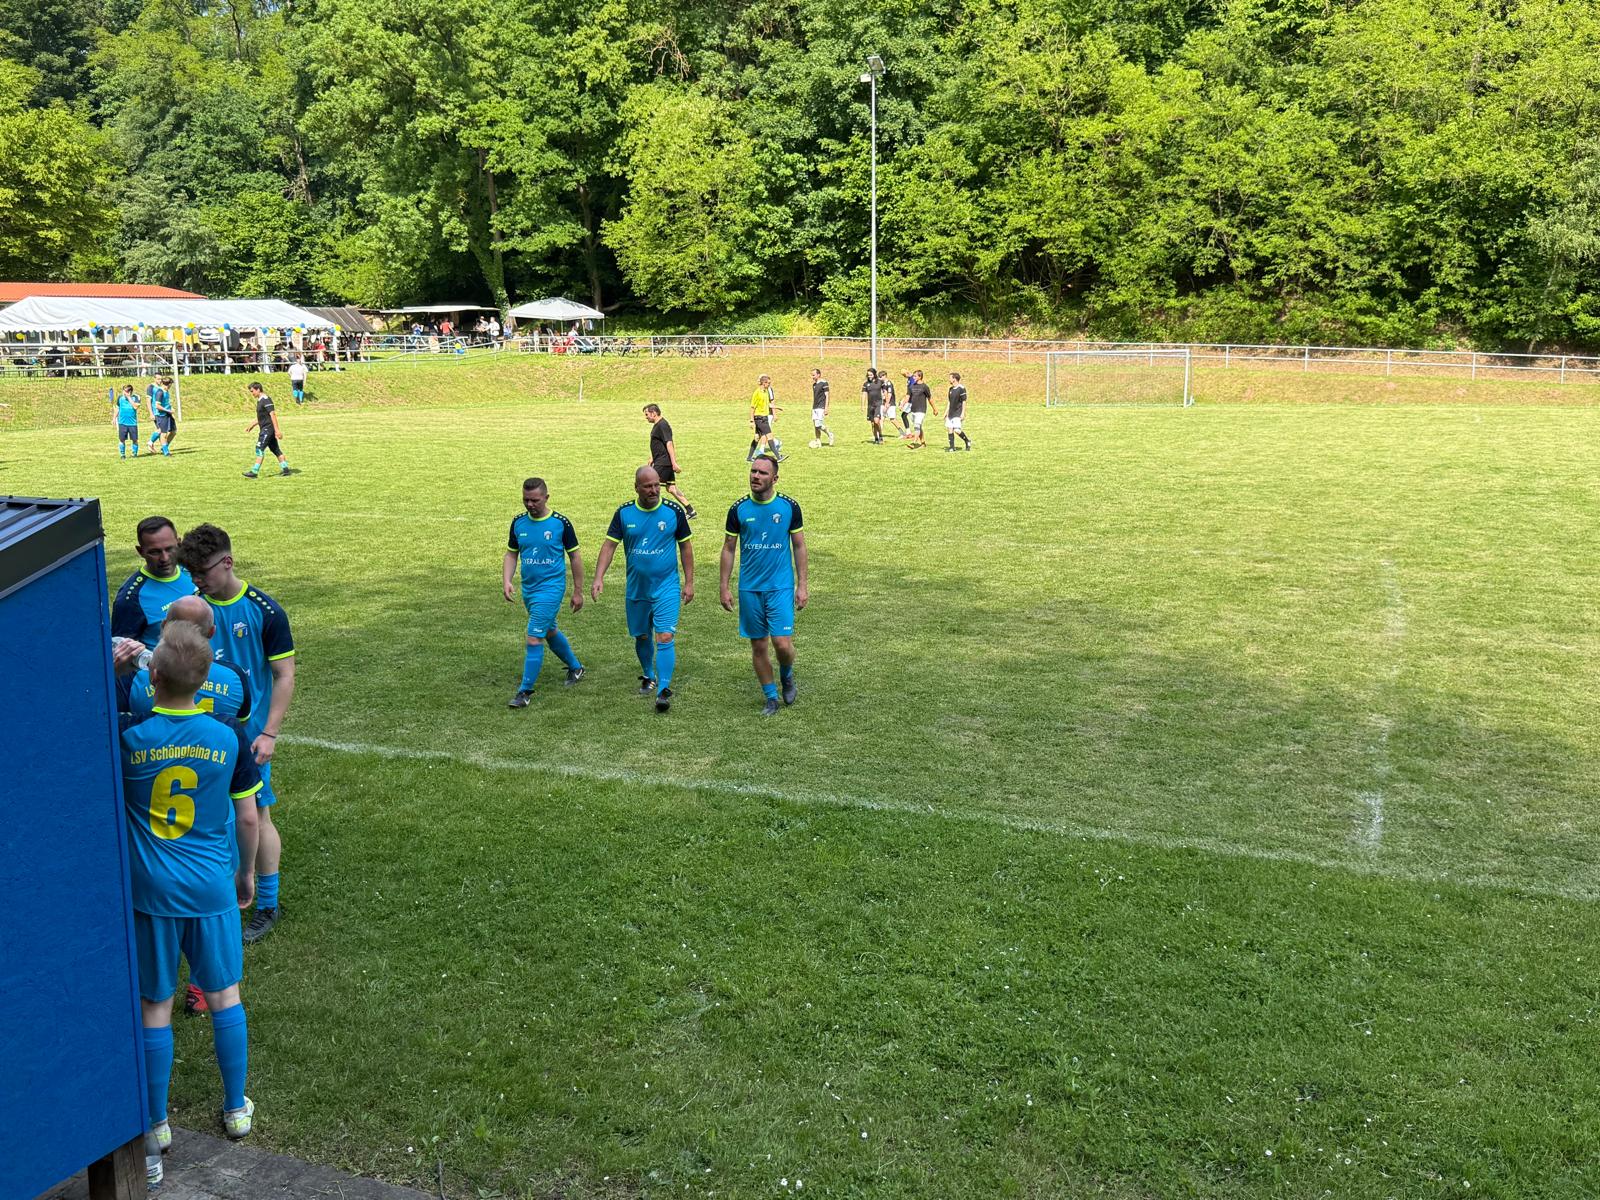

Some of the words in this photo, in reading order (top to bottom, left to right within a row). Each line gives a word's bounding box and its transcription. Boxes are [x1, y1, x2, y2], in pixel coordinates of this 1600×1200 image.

[145, 685, 156, 698] LS
[130, 750, 147, 765] LSV
[150, 744, 211, 761] Schöngleina
[212, 750, 227, 766] e.V.
[149, 765, 199, 840] 6
